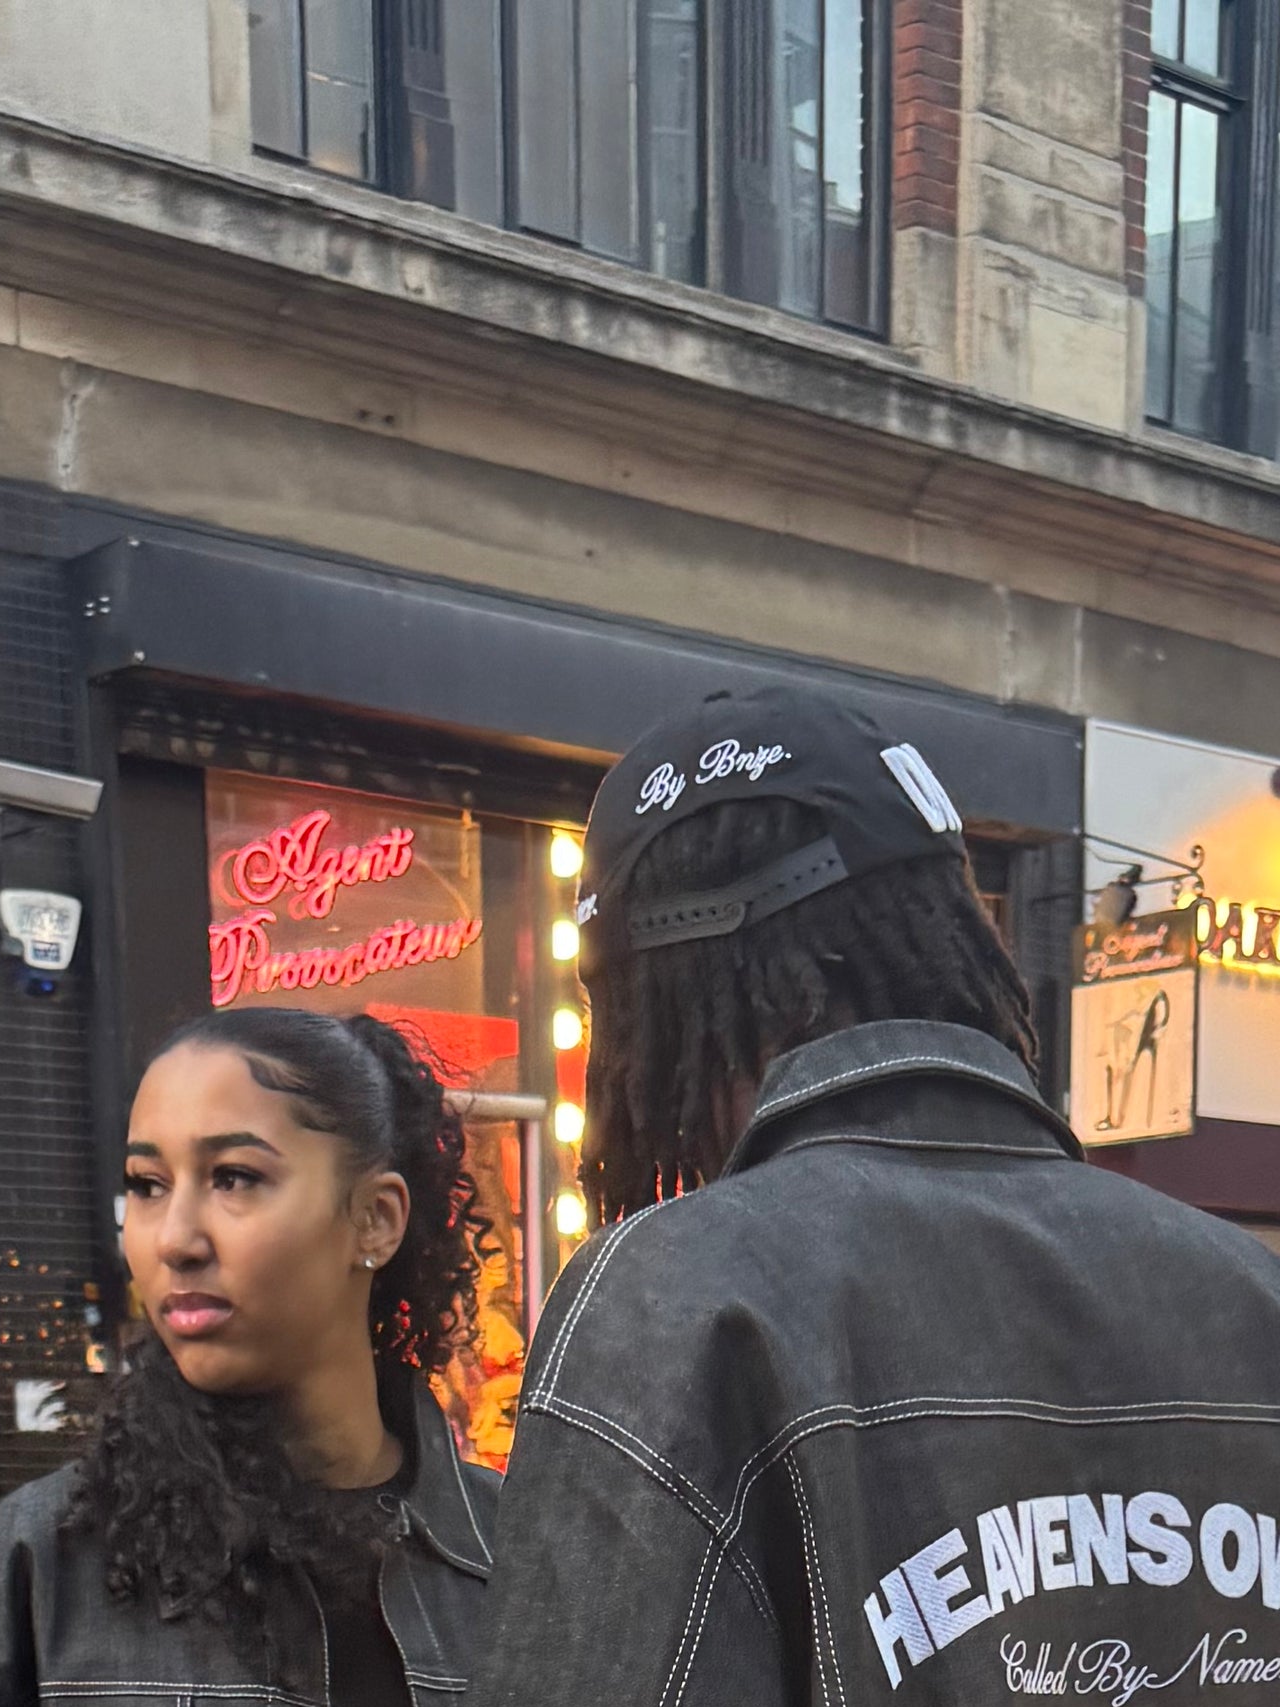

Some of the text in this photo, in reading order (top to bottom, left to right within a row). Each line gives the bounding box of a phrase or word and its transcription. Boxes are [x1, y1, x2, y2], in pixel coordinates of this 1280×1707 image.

[634, 762, 687, 815] By
[231, 809, 414, 919] Agent
[209, 909, 483, 1006] Provocateur
[1000, 1633, 1077, 1695] Called
[1074, 1638, 1148, 1707] By
